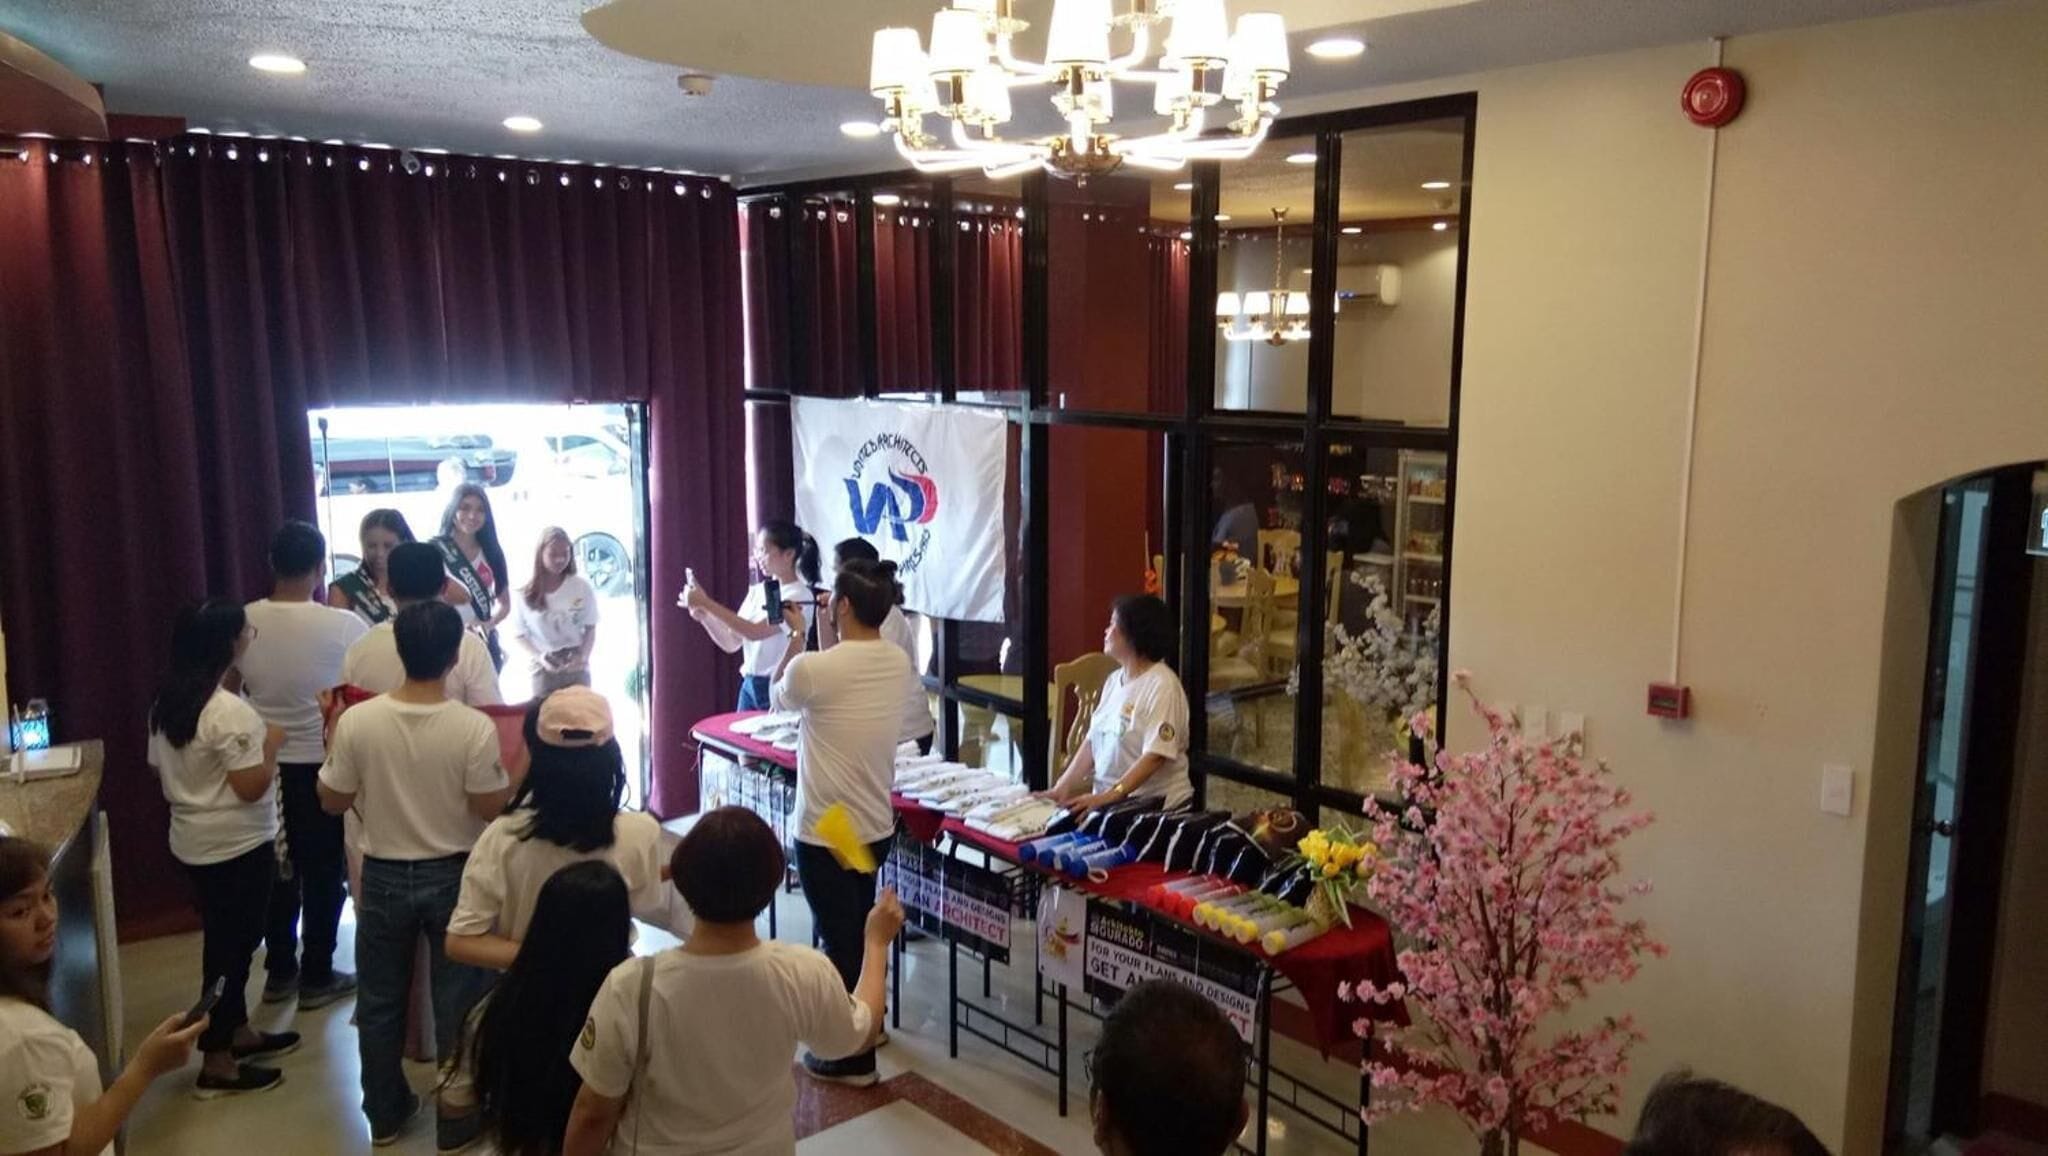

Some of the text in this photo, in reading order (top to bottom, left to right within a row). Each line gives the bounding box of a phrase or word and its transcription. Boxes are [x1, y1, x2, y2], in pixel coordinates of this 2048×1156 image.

[853, 431, 929, 479] UNITED ARCHITECTS
[934, 899, 1007, 943] ARCHITECT
[1090, 956, 1120, 981] GET
[1090, 940, 1110, 957] FOR
[1113, 950, 1141, 970] YOUR
[1144, 961, 1179, 984] PLANS
[1206, 985, 1250, 1015] DESIGNS
